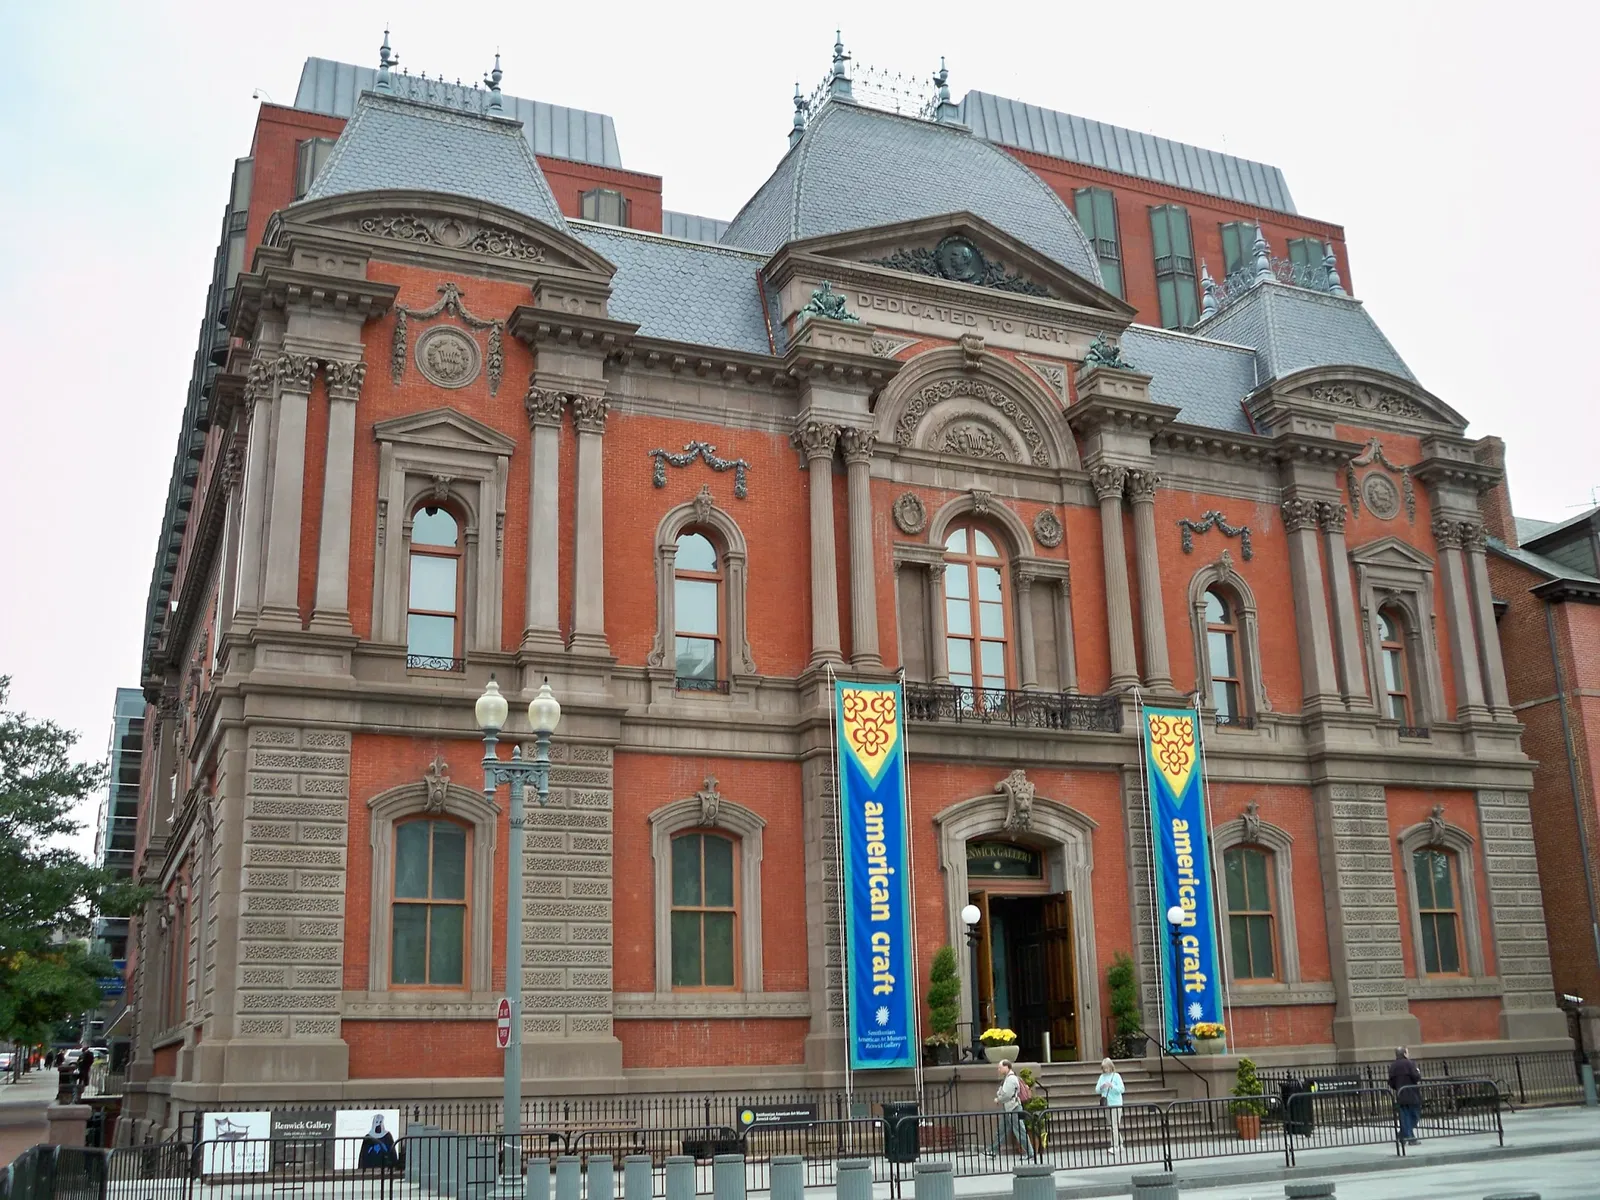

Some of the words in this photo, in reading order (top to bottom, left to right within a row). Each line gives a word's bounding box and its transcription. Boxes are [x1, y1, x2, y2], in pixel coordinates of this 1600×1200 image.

[858, 293, 977, 326] DEDICATED
[989, 316, 1015, 333] TO
[865, 801, 895, 921] american
[966, 847, 997, 860] ENWICK
[997, 847, 1032, 864] GALLERY
[1172, 818, 1200, 928] american
[871, 931, 895, 996] craft
[1182, 935, 1208, 993] craft
[275, 1121, 305, 1130] Renwick
[305, 1120, 333, 1131] Gallery
